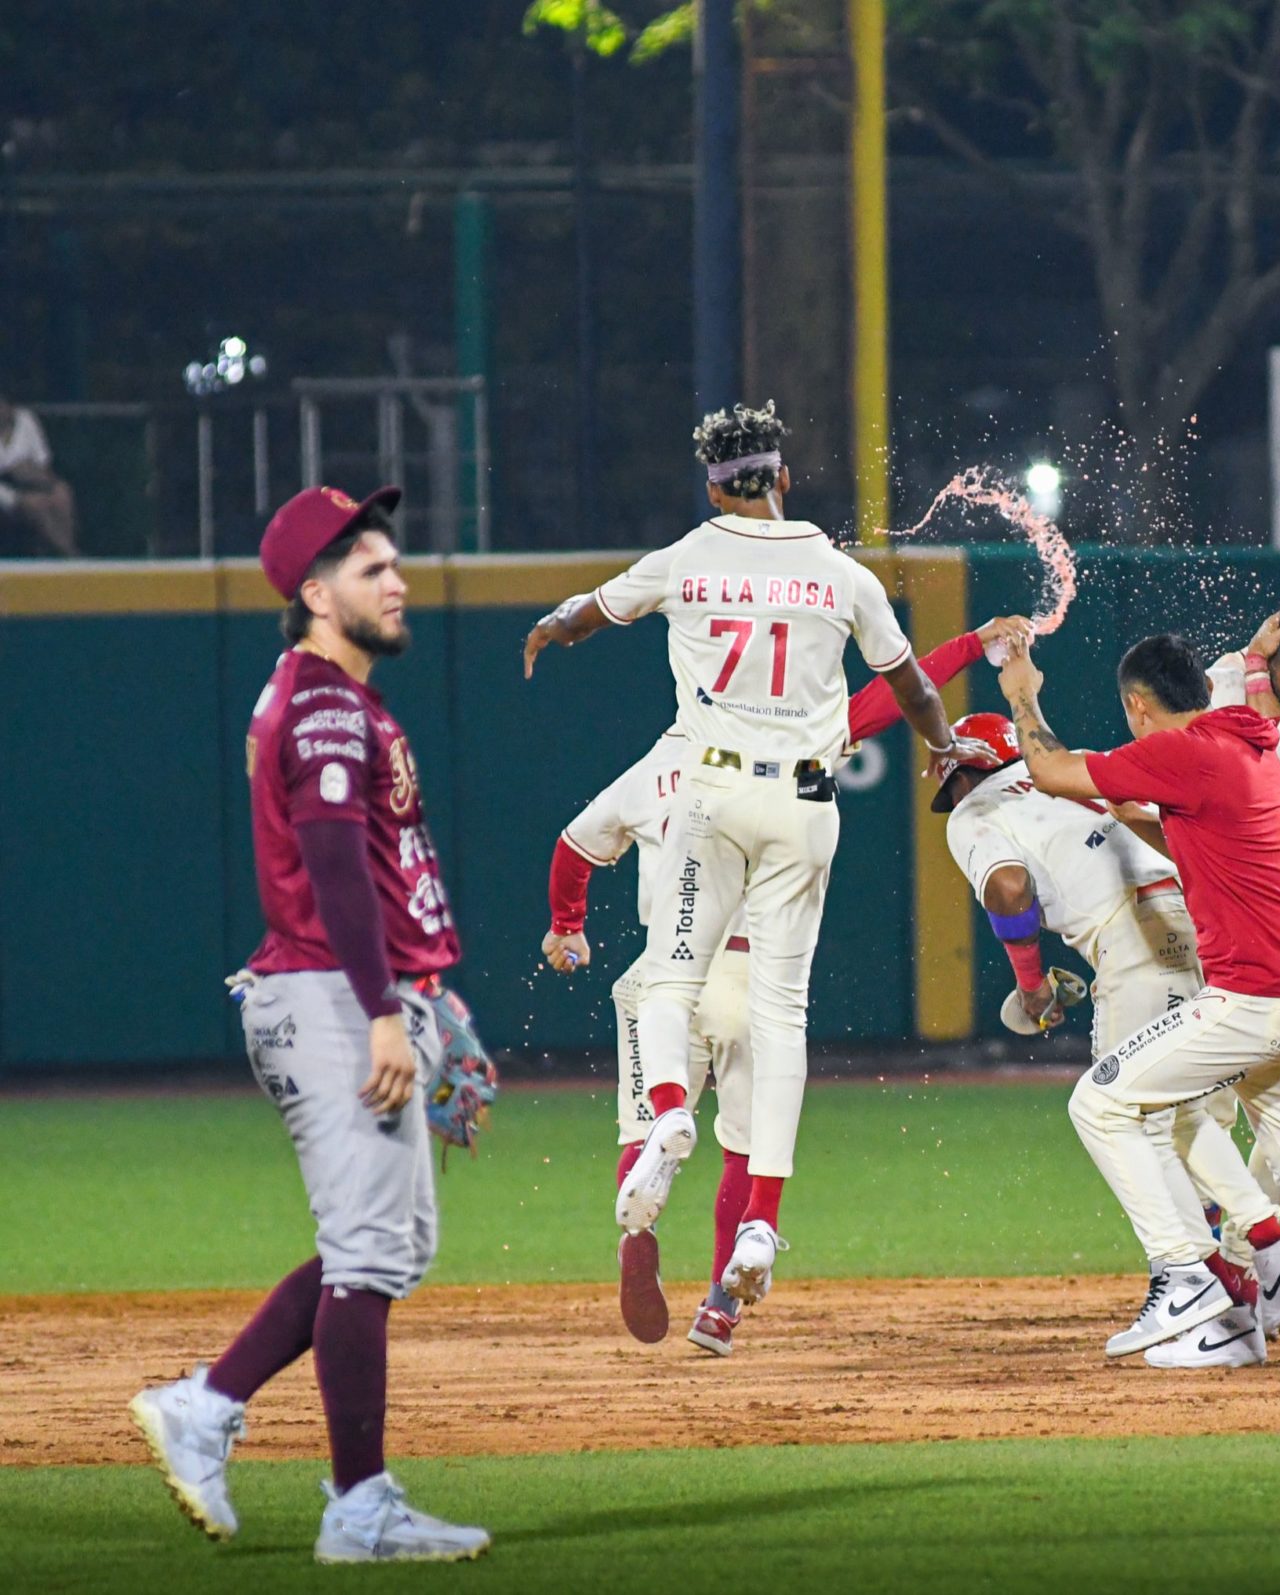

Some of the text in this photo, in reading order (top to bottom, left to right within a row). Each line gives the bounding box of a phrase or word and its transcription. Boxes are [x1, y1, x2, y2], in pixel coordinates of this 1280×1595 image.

[683, 578, 836, 610] DE LA ROSA
[709, 619, 790, 698] 71
[774, 706, 808, 718] Brands
[1001, 779, 1034, 795] VA
[675, 856, 702, 937] Totalplay
[1159, 944, 1190, 957] DELTA
[1118, 1011, 1182, 1056] CAFIVER
